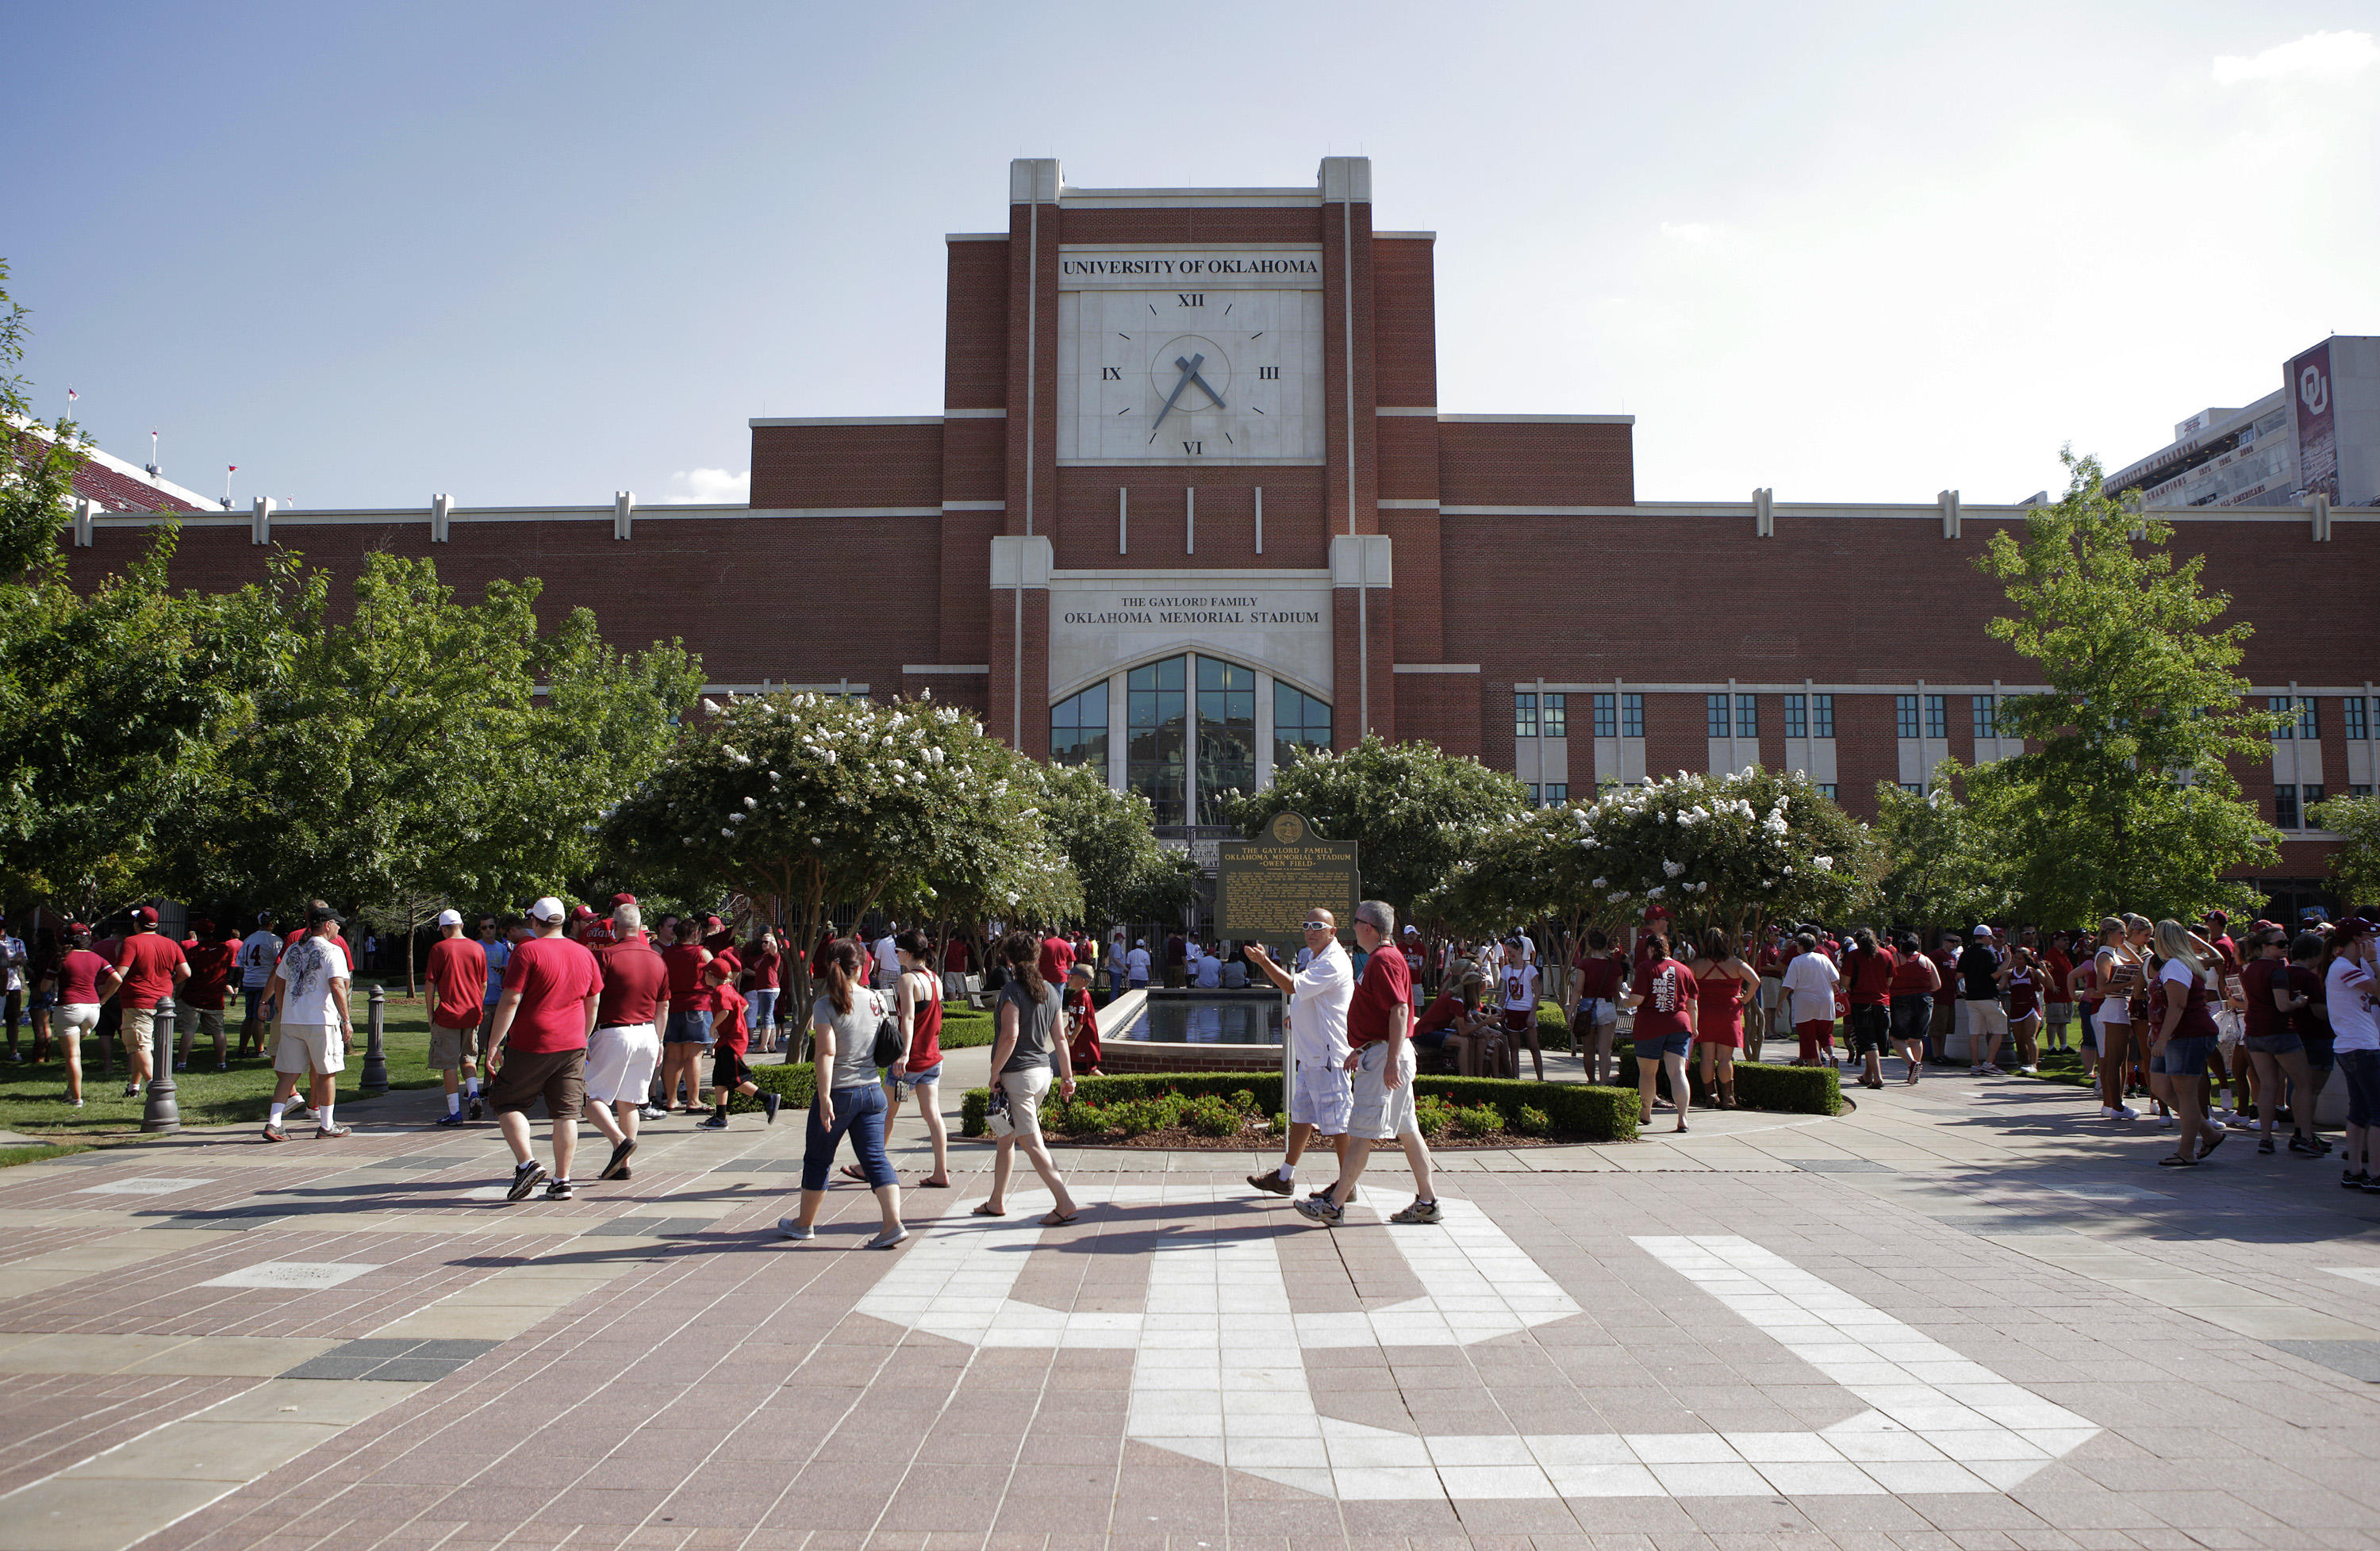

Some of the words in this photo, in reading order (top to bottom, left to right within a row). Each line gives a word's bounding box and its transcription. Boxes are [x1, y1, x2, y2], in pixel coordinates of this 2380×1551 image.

[1063, 260, 1176, 274] UNIVERSITY
[1179, 260, 1205, 274] OF
[1207, 259, 1319, 274] OKLAHOMA
[1178, 294, 1205, 307] XII
[1101, 367, 1122, 381] IX
[1259, 367, 1280, 380] III
[2301, 365, 2328, 415] OU
[1182, 441, 1203, 455] VI
[2157, 440, 2198, 467] OKLAHOMA
[2147, 476, 2186, 501] CHAMPIONS
[1121, 597, 1146, 607] THE
[1149, 597, 1207, 607] GAYLORD
[1211, 597, 1257, 606] FAMILY
[1065, 612, 1153, 624] OKLAHOMA
[1160, 612, 1244, 624] MEMORIAL
[1250, 612, 1319, 624] STADIUM
[245, 944, 261, 966] 14
[1508, 977, 1524, 1000] OU
[1835, 1002, 1845, 1012] OU
